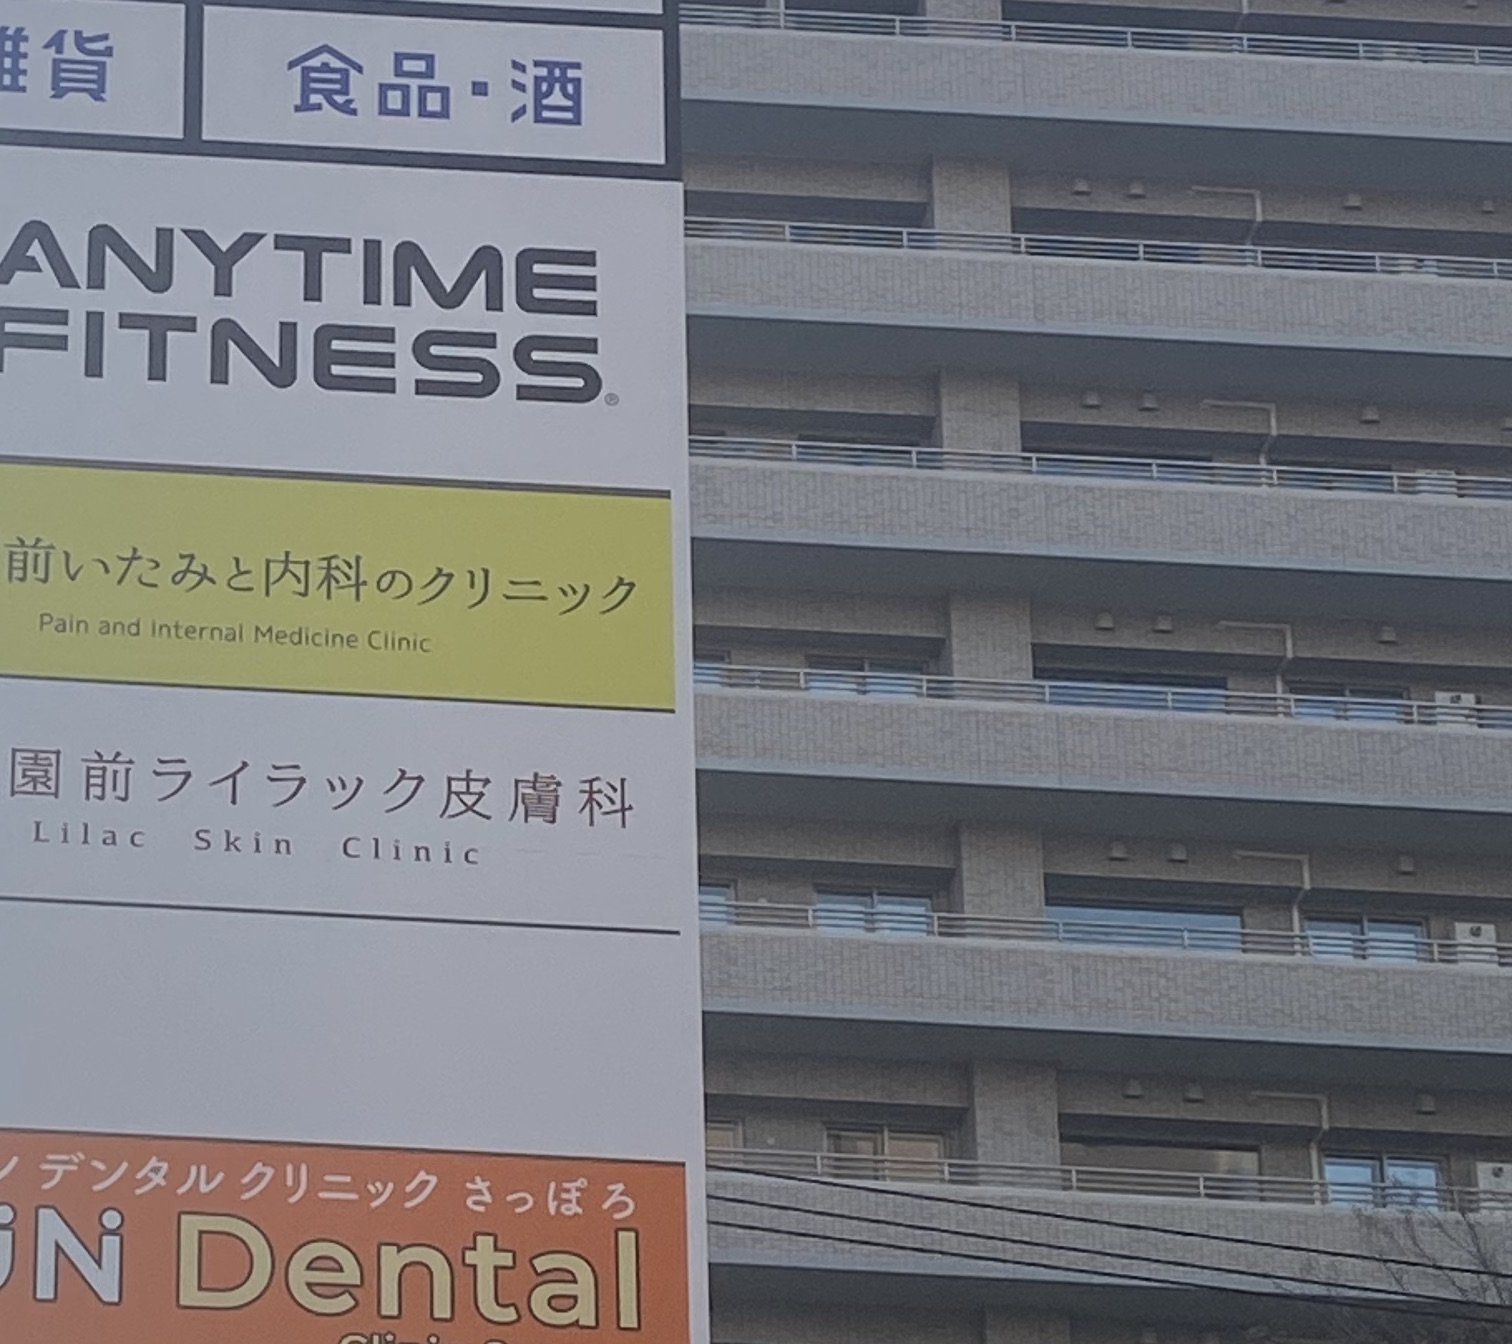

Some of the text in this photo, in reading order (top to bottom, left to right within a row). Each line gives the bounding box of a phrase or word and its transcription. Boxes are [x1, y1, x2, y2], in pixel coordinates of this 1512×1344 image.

[40, 613, 429, 652] Pain and Internal Medicine Clinic
[34, 821, 478, 864] Lilac Skin Clinic
[40, 1152, 224, 1195] デンタル
[241, 1162, 437, 1208] クリニック
[466, 1176, 634, 1219] さっぽろ
[175, 1209, 642, 1331] Dental
